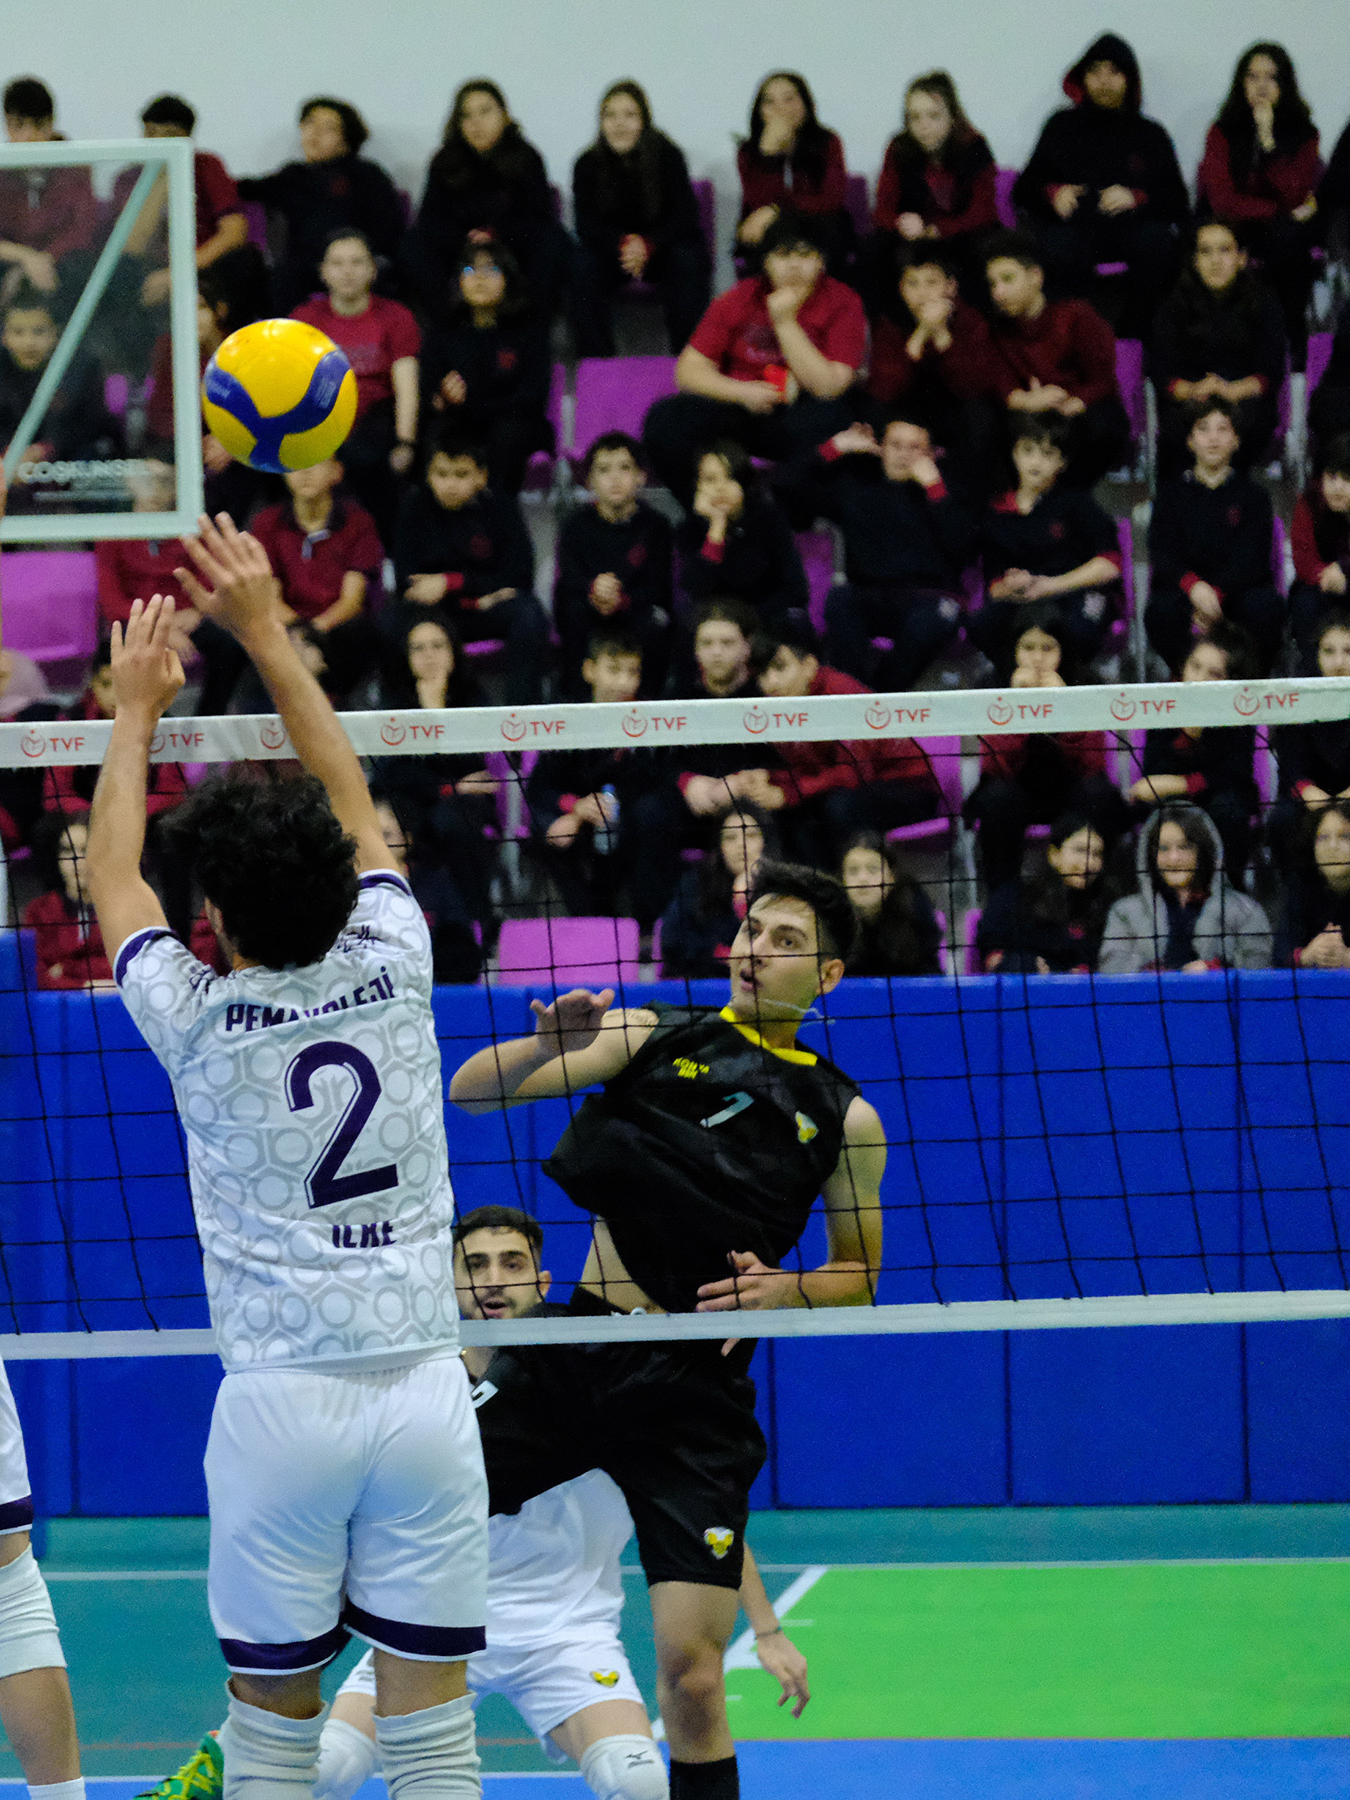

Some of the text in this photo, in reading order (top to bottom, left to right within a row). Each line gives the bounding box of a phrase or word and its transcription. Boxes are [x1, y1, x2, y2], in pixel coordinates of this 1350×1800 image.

[49, 735, 85, 752] TVF
[169, 731, 204, 748] TVF
[409, 724, 445, 740] TVF
[529, 719, 566, 736] TVF
[651, 716, 687, 731] TVF
[773, 712, 809, 728] TVF
[894, 707, 931, 723] TVF
[1017, 703, 1053, 719] TVF
[1140, 699, 1176, 715] TVF
[1264, 692, 1299, 709] TVF
[284, 1041, 399, 1209] 2
[699, 1091, 754, 1128] 7
